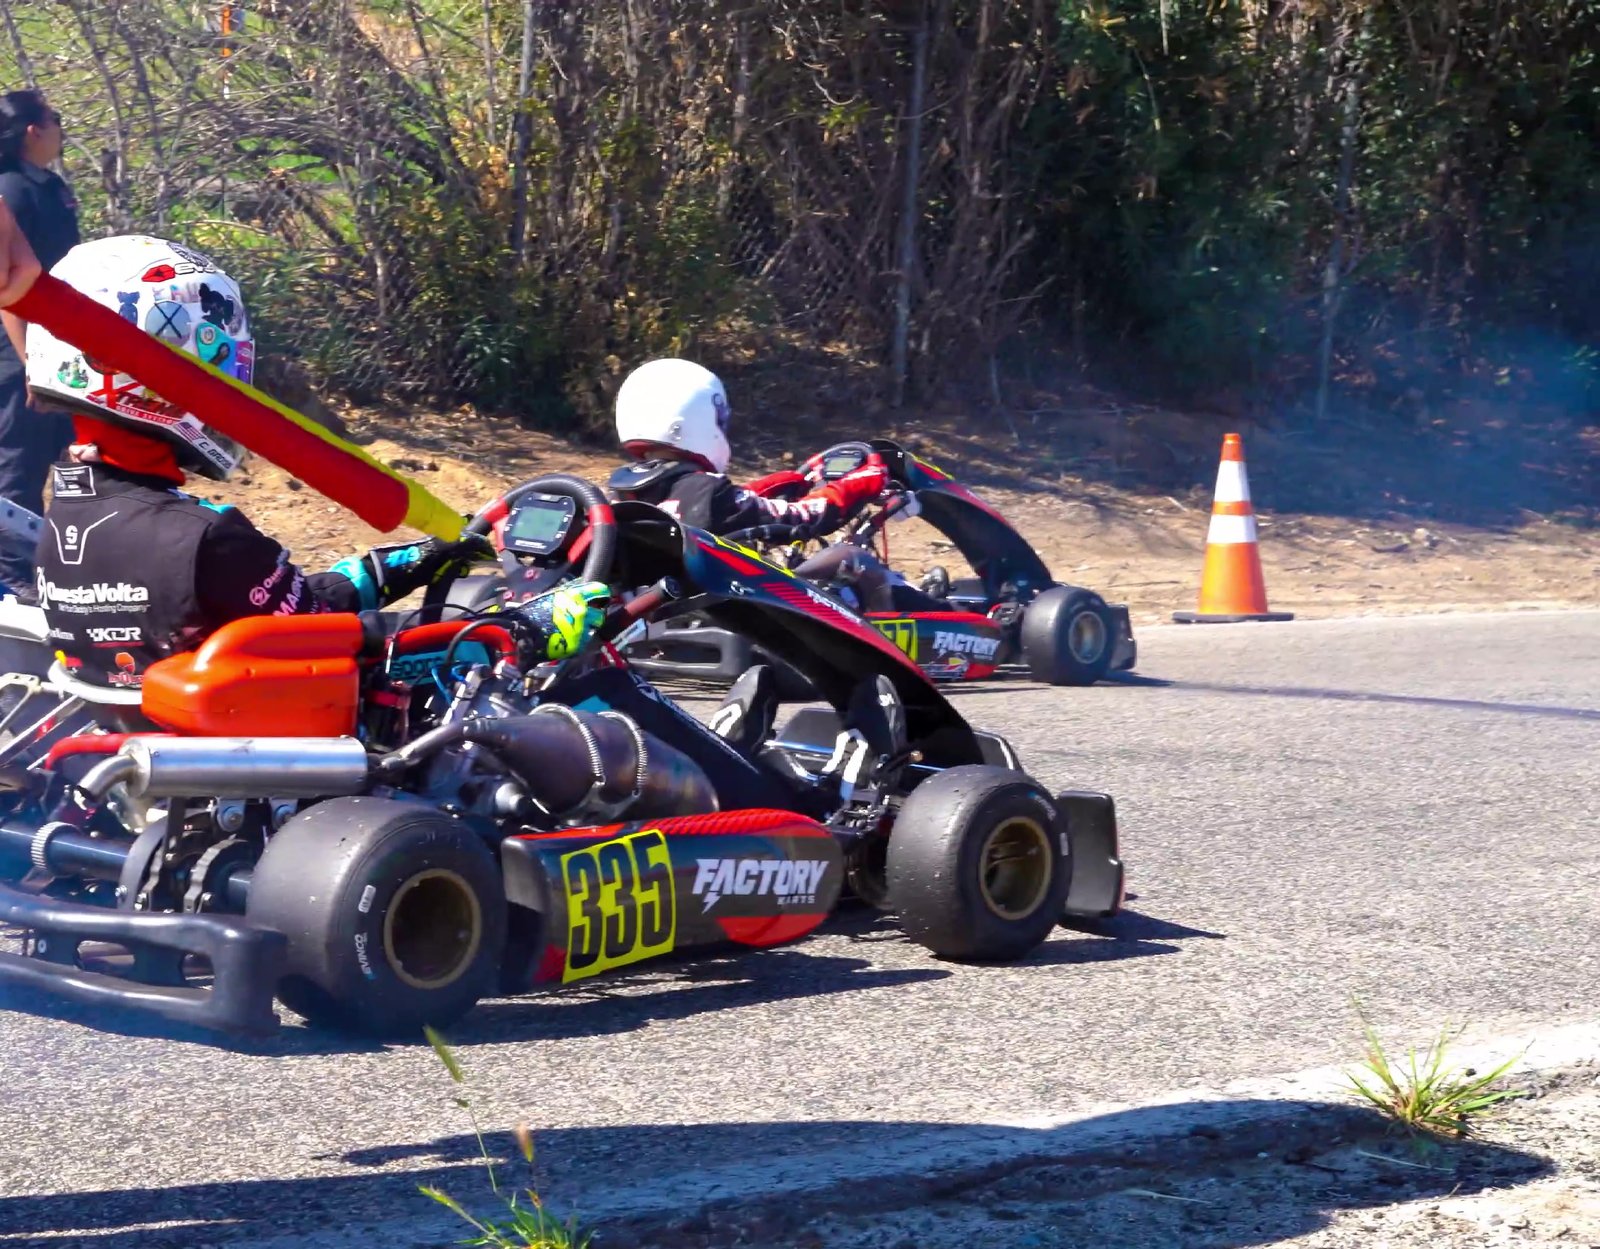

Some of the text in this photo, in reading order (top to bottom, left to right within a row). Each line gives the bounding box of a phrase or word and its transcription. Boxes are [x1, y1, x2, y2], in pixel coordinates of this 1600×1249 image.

[932, 630, 1001, 656] FACTORY
[691, 857, 829, 899] FACTORY
[568, 831, 671, 970] 335
